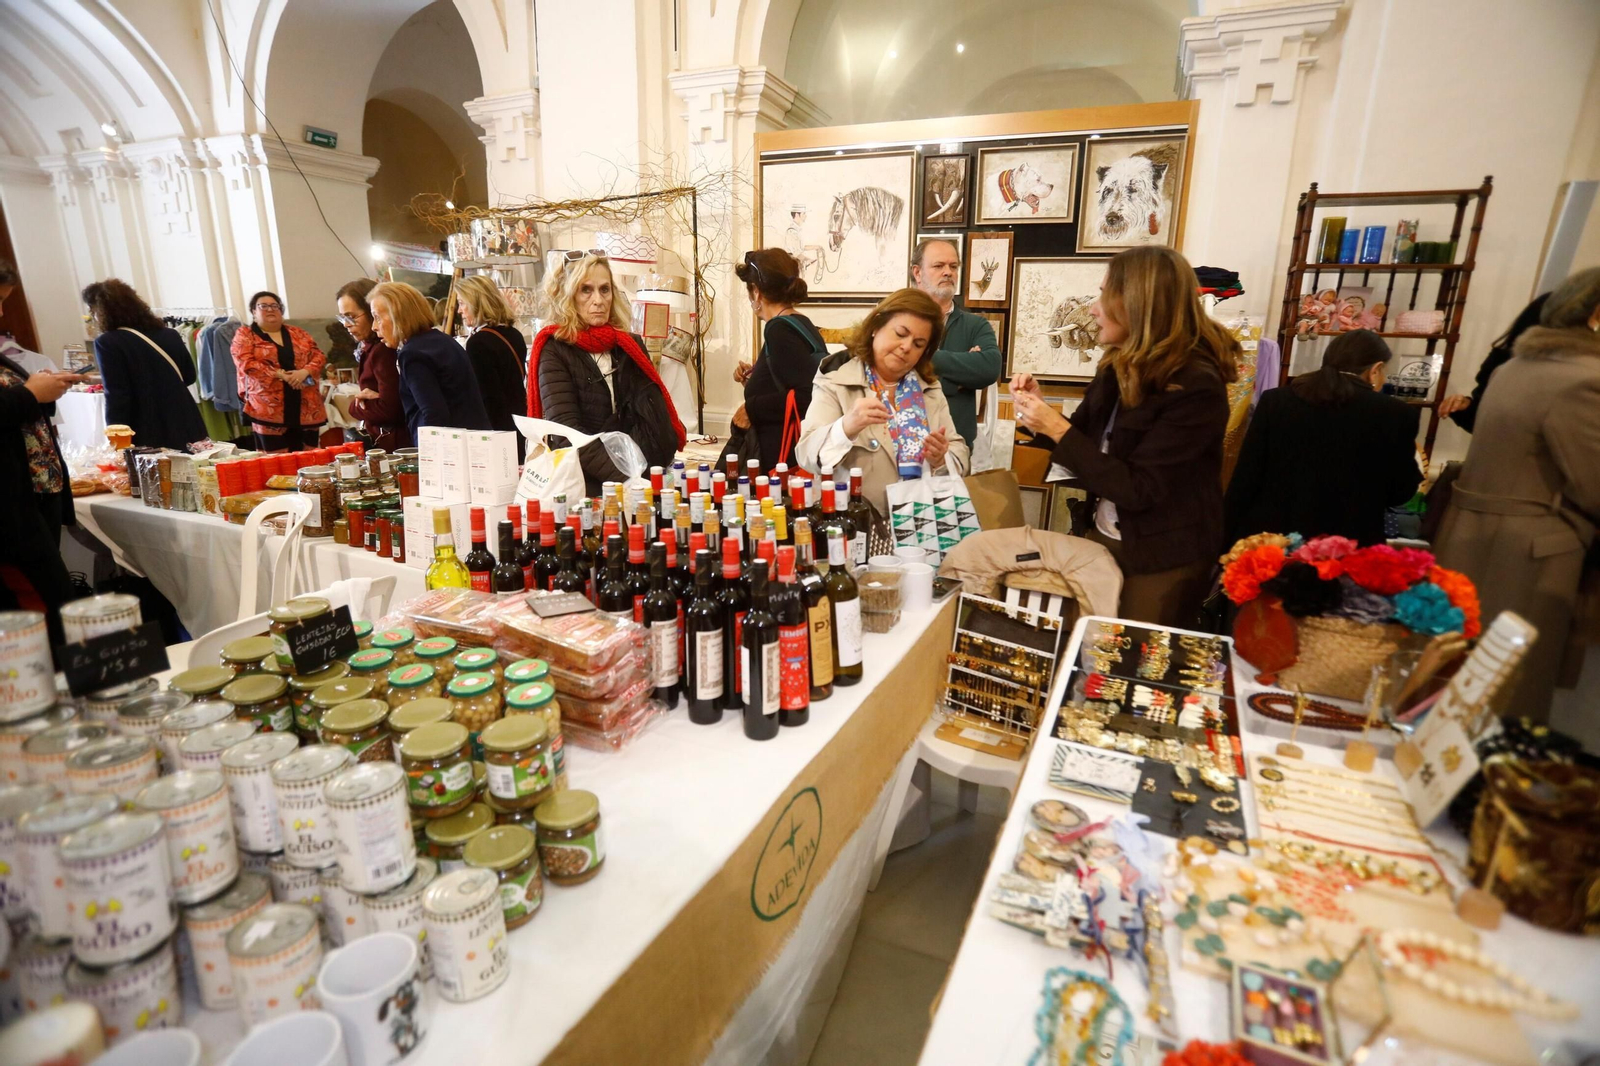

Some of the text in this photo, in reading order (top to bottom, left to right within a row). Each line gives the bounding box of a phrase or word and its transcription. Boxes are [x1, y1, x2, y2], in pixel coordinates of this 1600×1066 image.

[296, 622, 337, 645] LENTEJAS
[296, 624, 351, 655] GUISADAS ECO
[288, 840, 334, 855] GUISO
[767, 837, 816, 913] ADEVIDA
